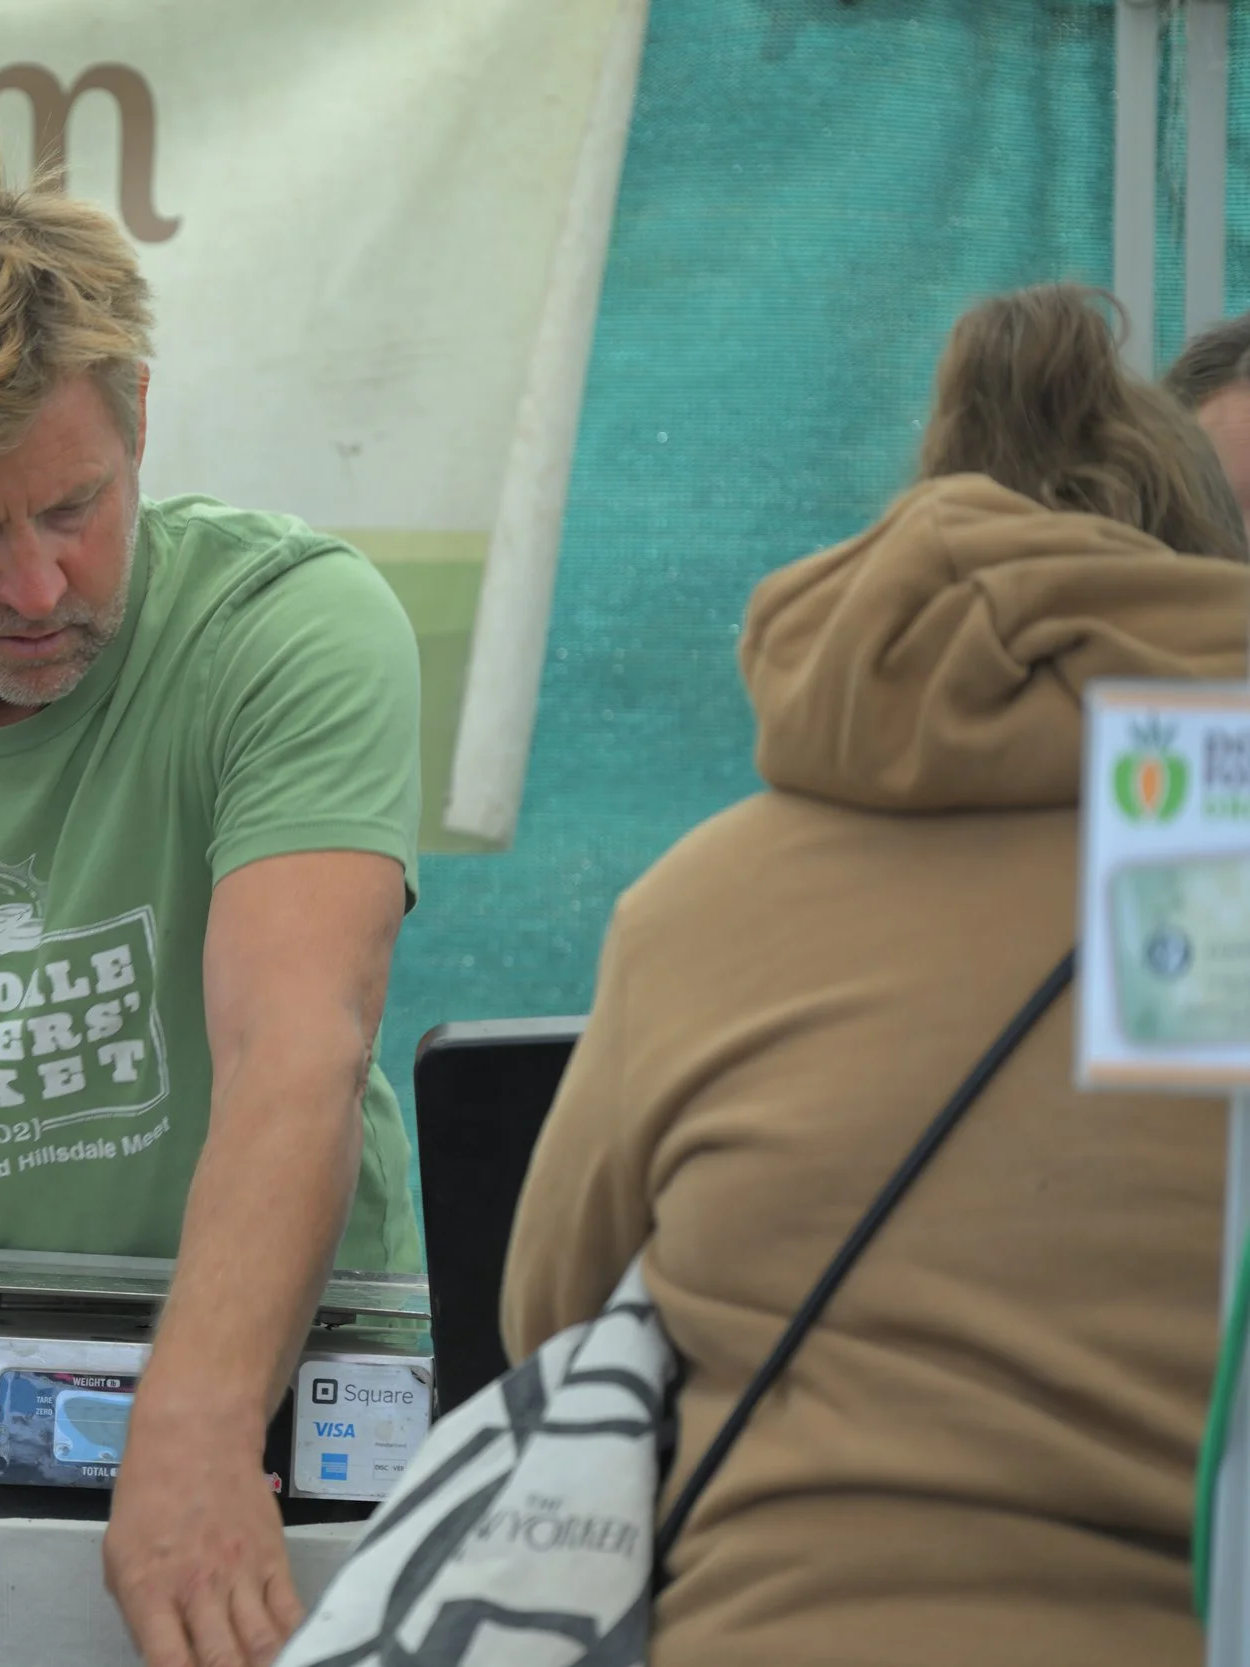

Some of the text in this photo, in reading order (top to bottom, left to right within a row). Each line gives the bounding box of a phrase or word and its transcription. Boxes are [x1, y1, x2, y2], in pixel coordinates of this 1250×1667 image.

[18, 1137, 117, 1172] Hillsdale
[121, 1115, 172, 1157] Meet
[73, 1377, 106, 1387] WEIGHT
[36, 1396, 53, 1404] TARE
[344, 1384, 414, 1406] Square
[36, 1408, 53, 1416] ZERO
[313, 1421, 356, 1438] VISA
[82, 1466, 109, 1477] TOTAL
